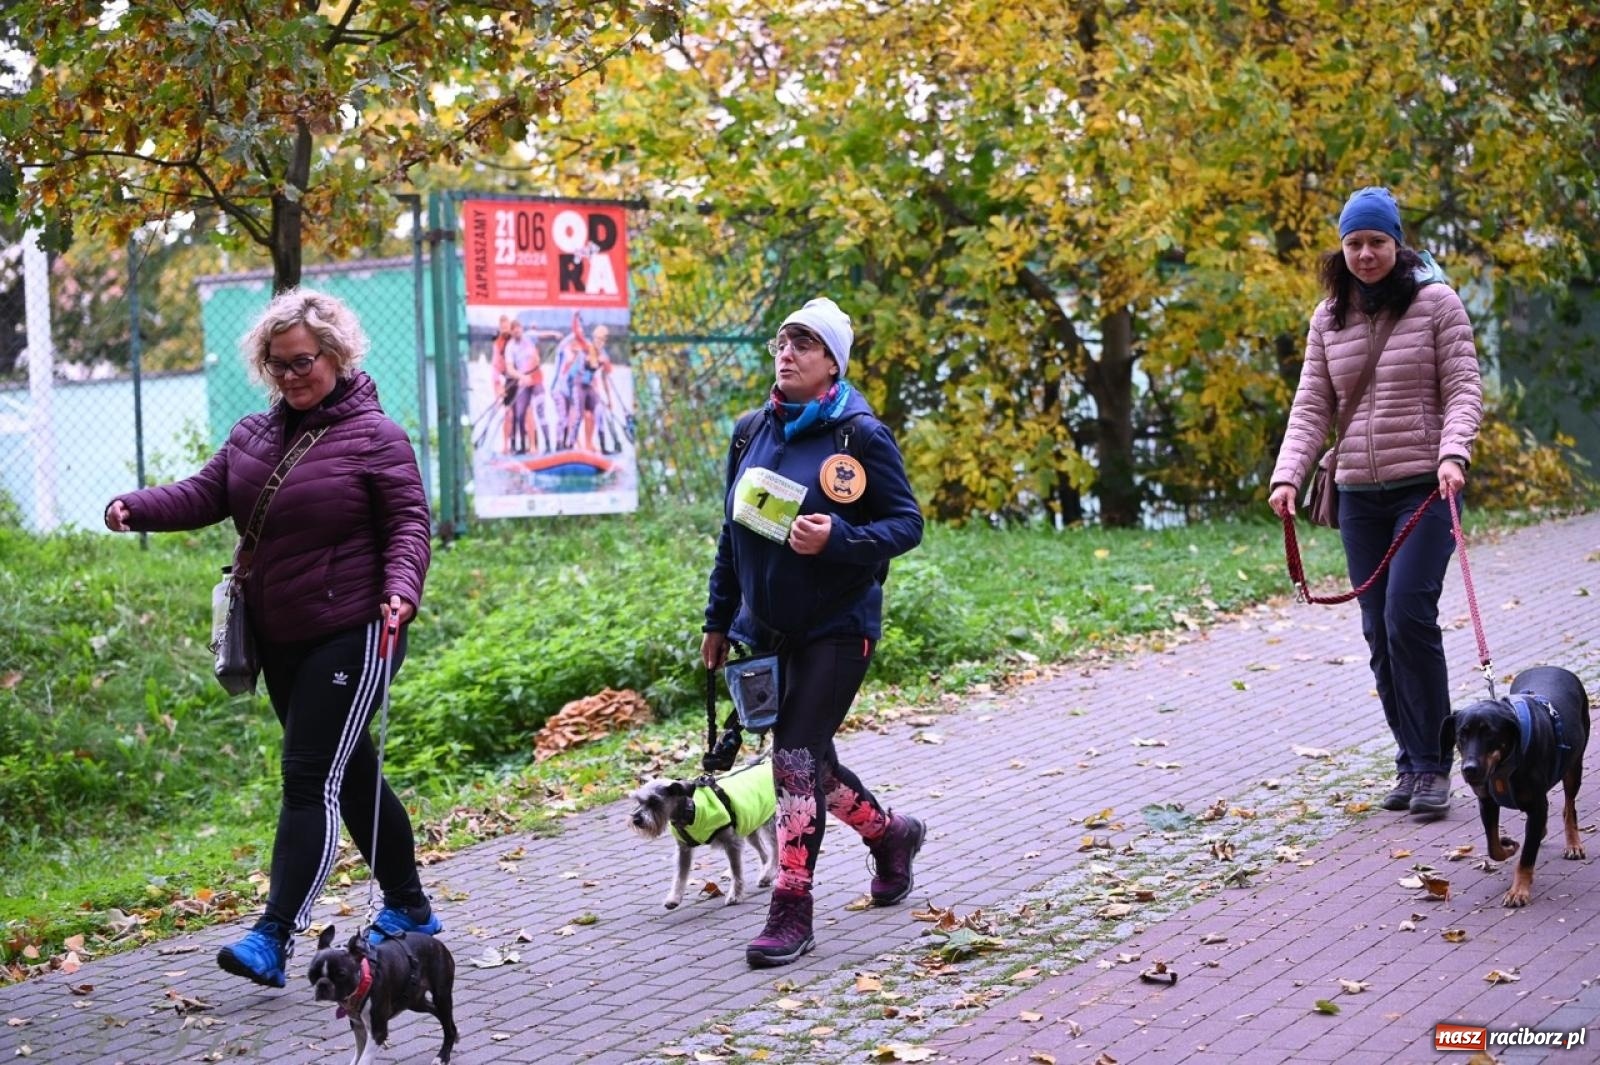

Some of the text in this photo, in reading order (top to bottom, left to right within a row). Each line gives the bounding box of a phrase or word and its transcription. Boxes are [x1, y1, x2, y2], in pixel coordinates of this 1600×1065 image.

[495, 210, 515, 237] 21
[517, 211, 546, 251] 06
[473, 210, 489, 298] ZAPRASZAMY
[494, 238, 516, 265] 23
[757, 492, 770, 509] 1
